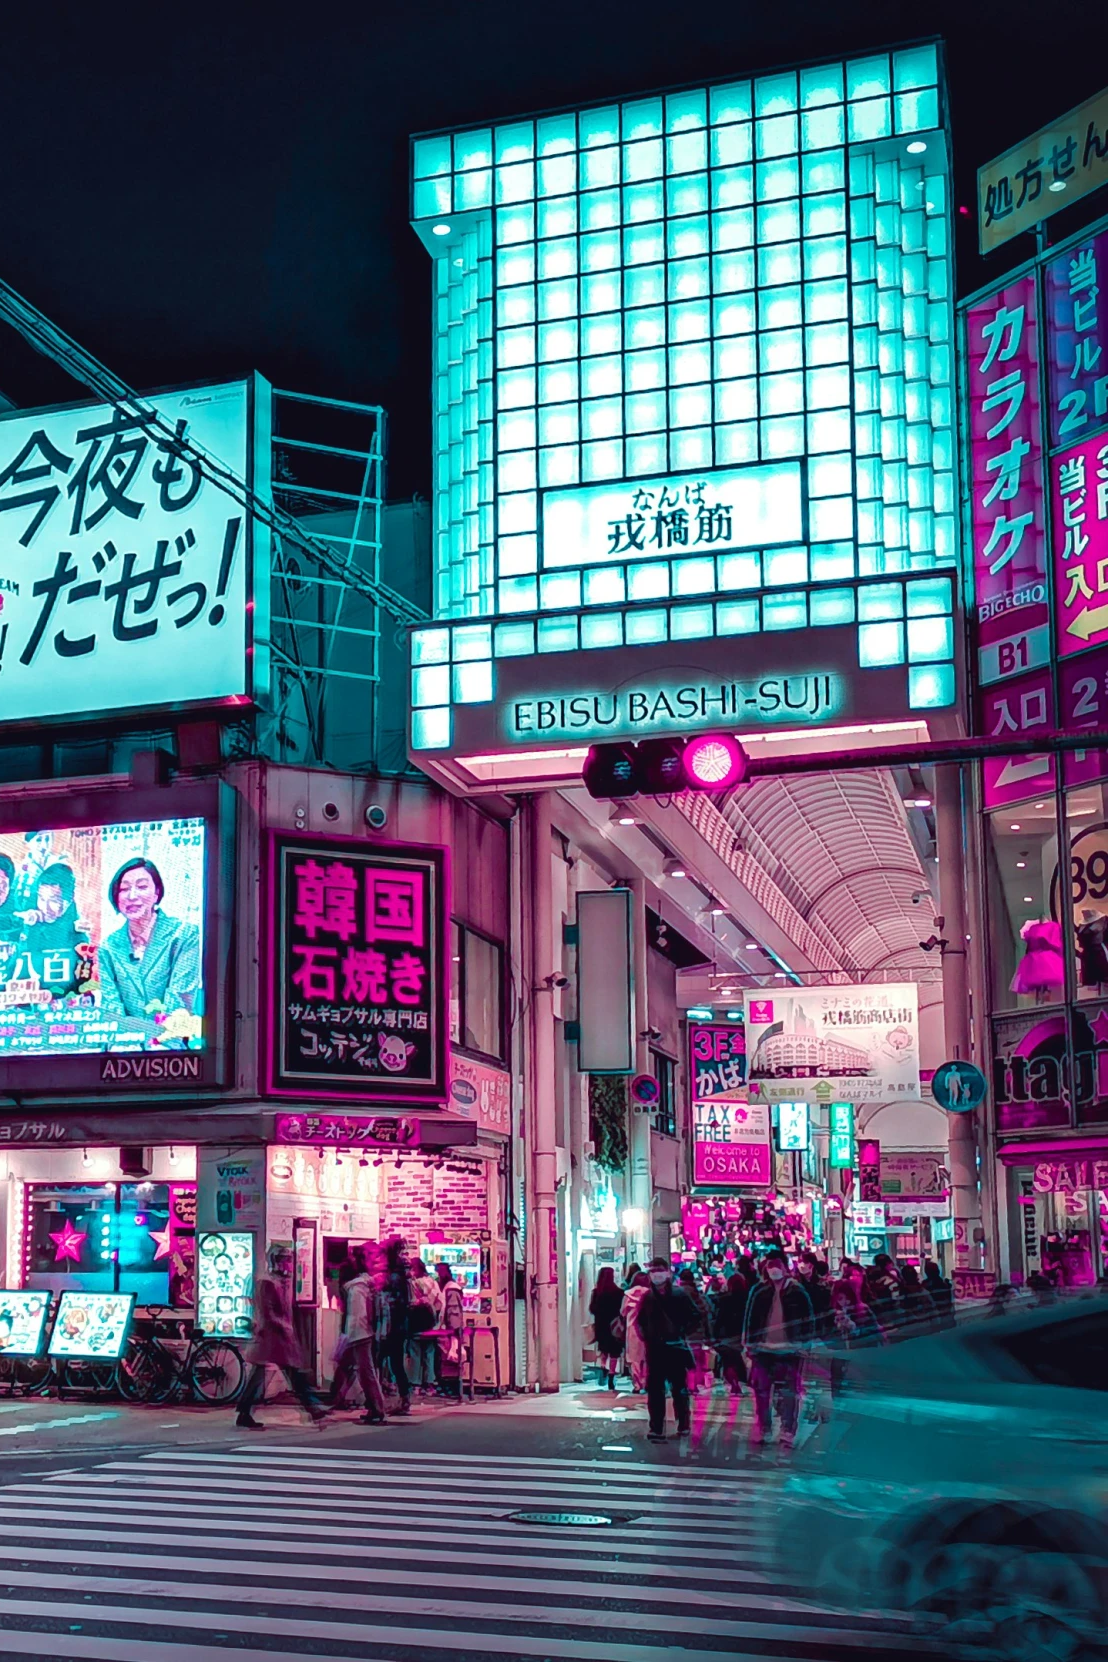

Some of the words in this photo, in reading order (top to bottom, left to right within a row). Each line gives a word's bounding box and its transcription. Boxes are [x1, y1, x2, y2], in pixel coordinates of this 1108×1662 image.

[985, 120, 1108, 228] 処方せん
[1068, 248, 1102, 380] 当ビル
[979, 305, 1034, 576] カラオケ
[632, 481, 708, 509] なんば
[1059, 455, 1089, 560] 当ビル
[607, 503, 734, 555] 戎橋筋
[19, 516, 242, 666] だぜっ!
[979, 597, 1005, 625] BIG
[1005, 584, 1045, 609] ECHO
[998, 636, 1028, 675] B1
[514, 694, 618, 732] EBISU
[992, 687, 1047, 737] 入口
[295, 859, 424, 947] 韓国
[292, 944, 426, 1005] 石焼き
[821, 1007, 913, 1026] 戎橋筋商店街
[101, 1056, 199, 1079] ADVISION
[695, 1104, 730, 1124] TAX
[695, 1123, 732, 1142] FREE
[703, 1145, 747, 1156] Welcome
[750, 1146, 760, 1156] to
[703, 1156, 761, 1173] OSAKA
[1033, 1160, 1108, 1193] SALE
[954, 1276, 995, 1299] SALE
